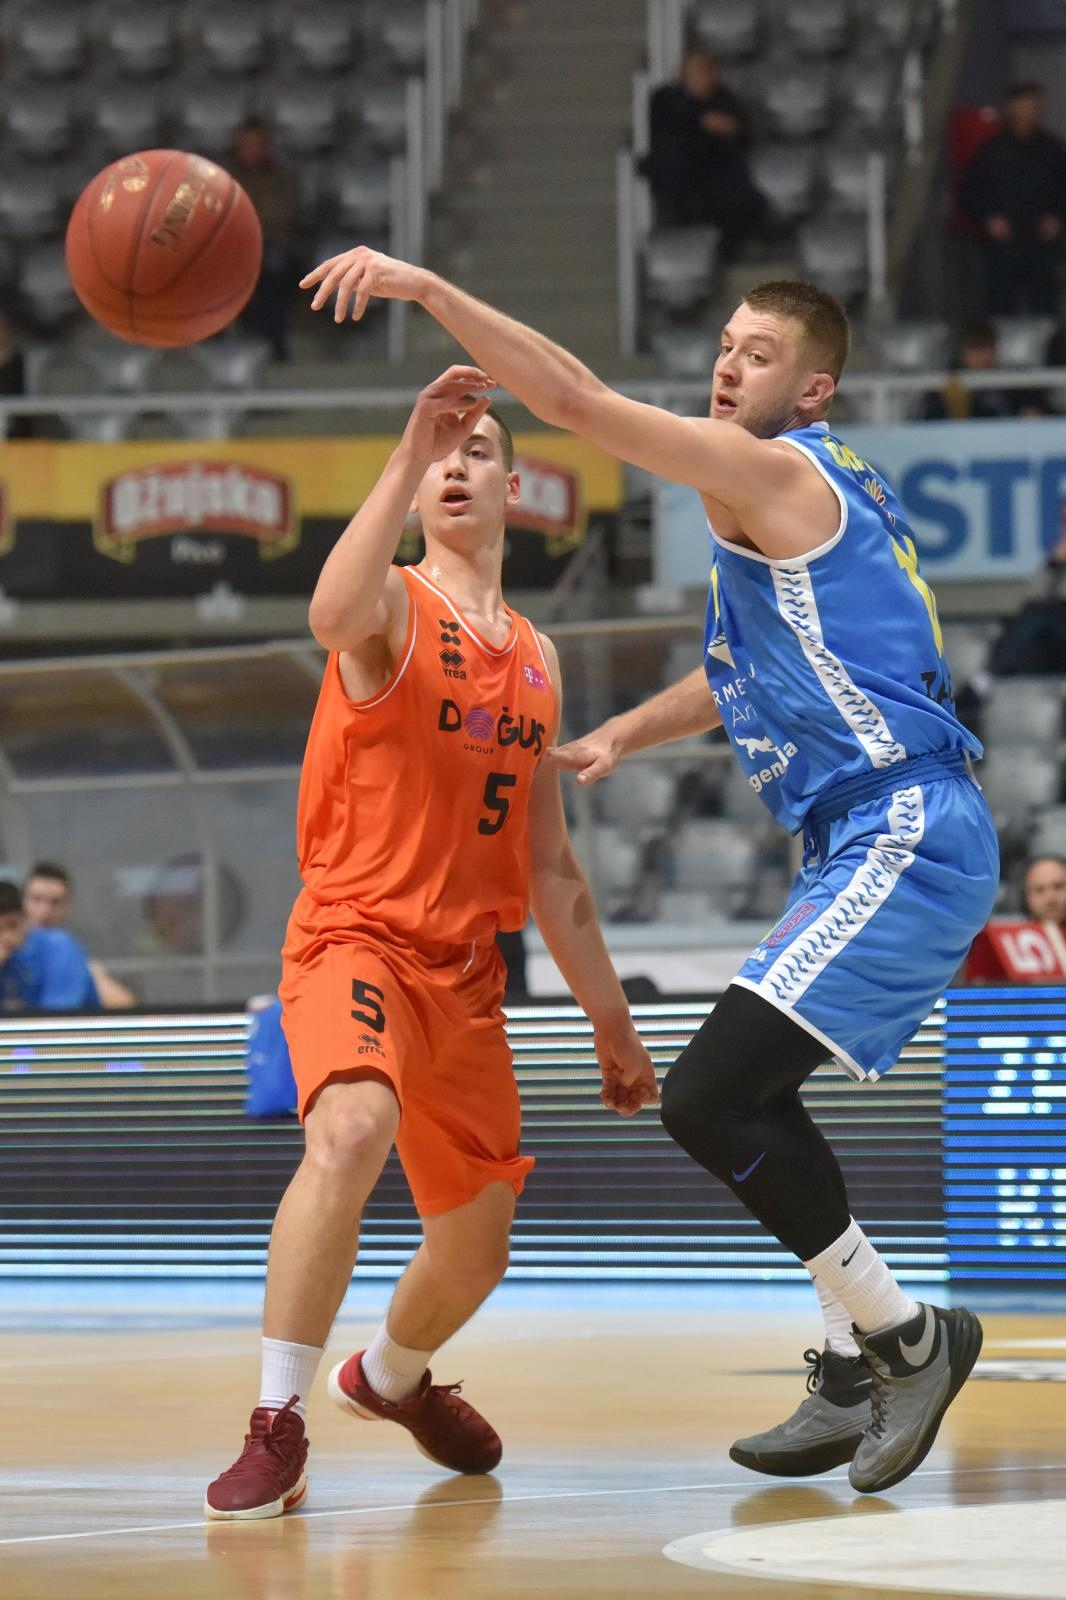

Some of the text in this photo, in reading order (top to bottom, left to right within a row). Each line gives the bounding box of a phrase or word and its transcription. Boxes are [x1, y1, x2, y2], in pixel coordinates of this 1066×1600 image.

[902, 458, 1066, 562] ST
[443, 668, 467, 680] rrea
[463, 743, 494, 755] GROUP
[477, 771, 517, 836] 5
[351, 978, 386, 1033] 5
[998, 1168, 1066, 1246] K
